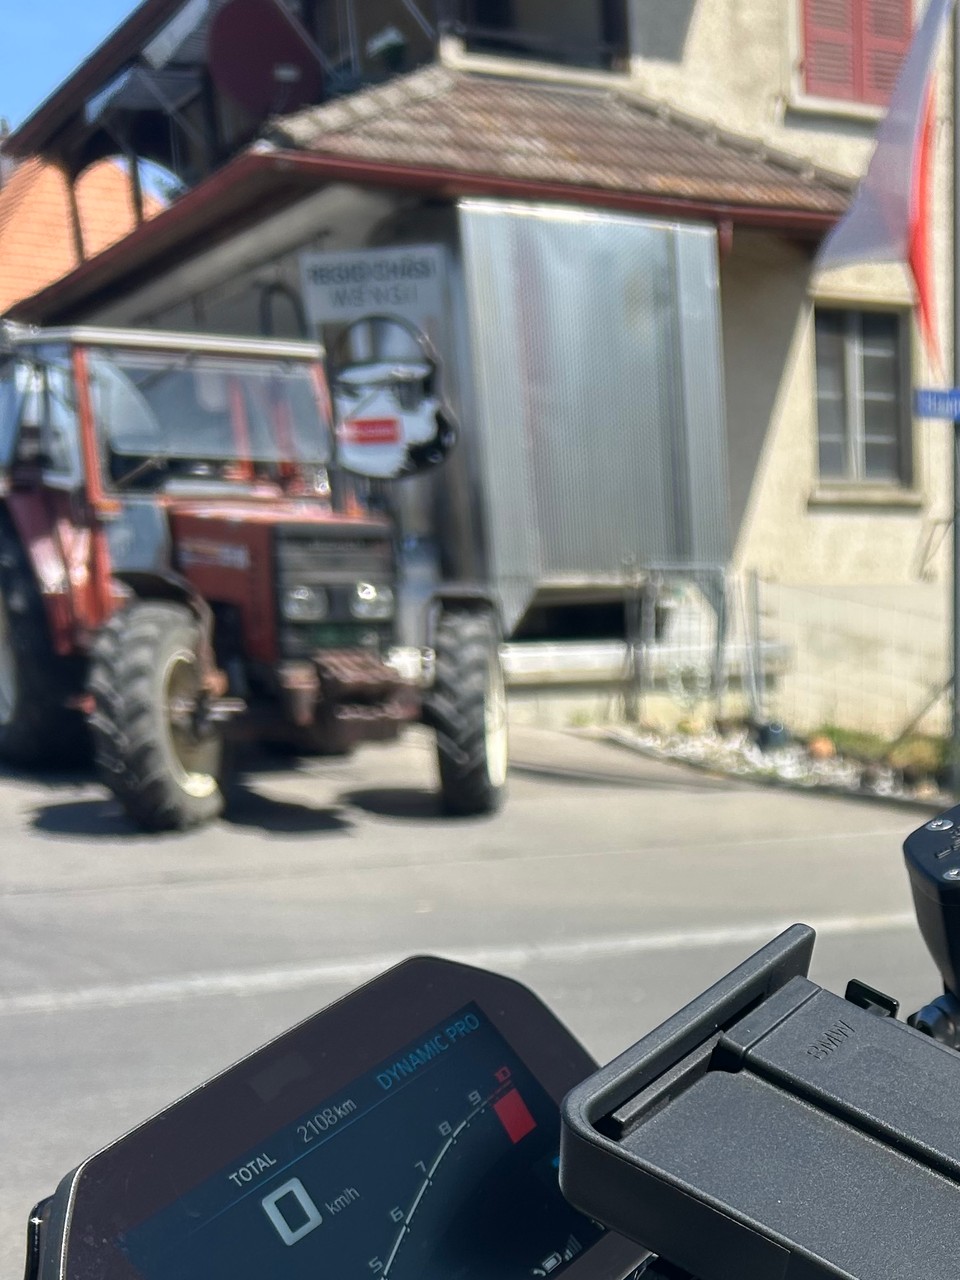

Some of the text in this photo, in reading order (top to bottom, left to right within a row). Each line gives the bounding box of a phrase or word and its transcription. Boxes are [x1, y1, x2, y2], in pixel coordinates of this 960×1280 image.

[807, 1019, 855, 1060] BMW
[376, 1012, 481, 1090] DYNAMIC PRO
[468, 1090, 482, 1105] 9
[438, 1120, 452, 1136] 8
[229, 1152, 277, 1187] TOTAL
[414, 1160, 427, 1173] 7
[261, 1176, 360, 1247] 0 km/h
[389, 1206, 404, 1222] 6
[368, 1256, 384, 1273] 5
